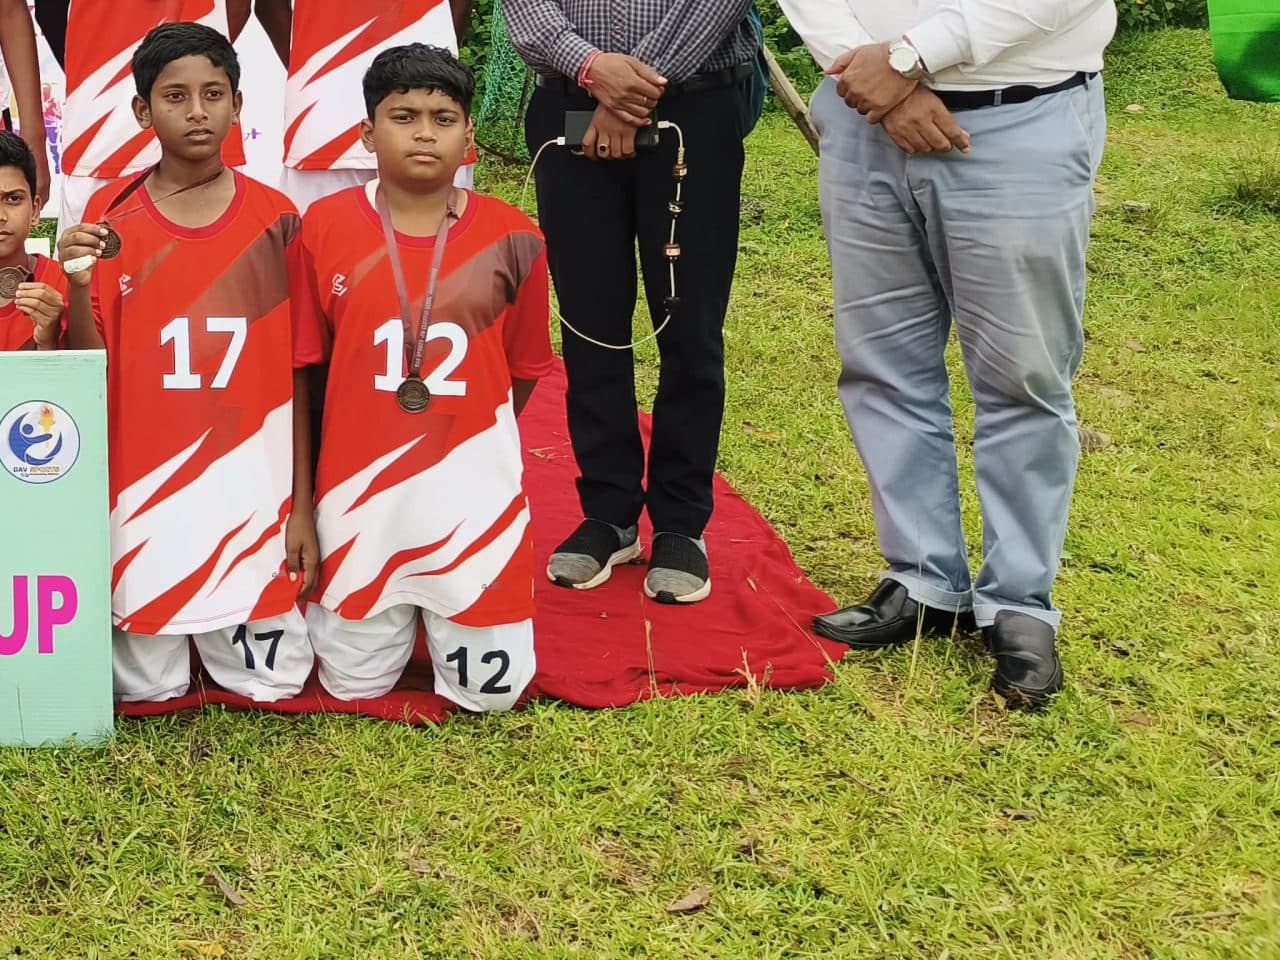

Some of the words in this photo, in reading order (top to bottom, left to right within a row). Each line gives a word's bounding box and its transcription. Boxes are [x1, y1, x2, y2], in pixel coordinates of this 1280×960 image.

[160, 316, 248, 390] 17
[373, 318, 468, 396] 12
[232, 623, 285, 671] 17
[446, 645, 512, 695] 12
